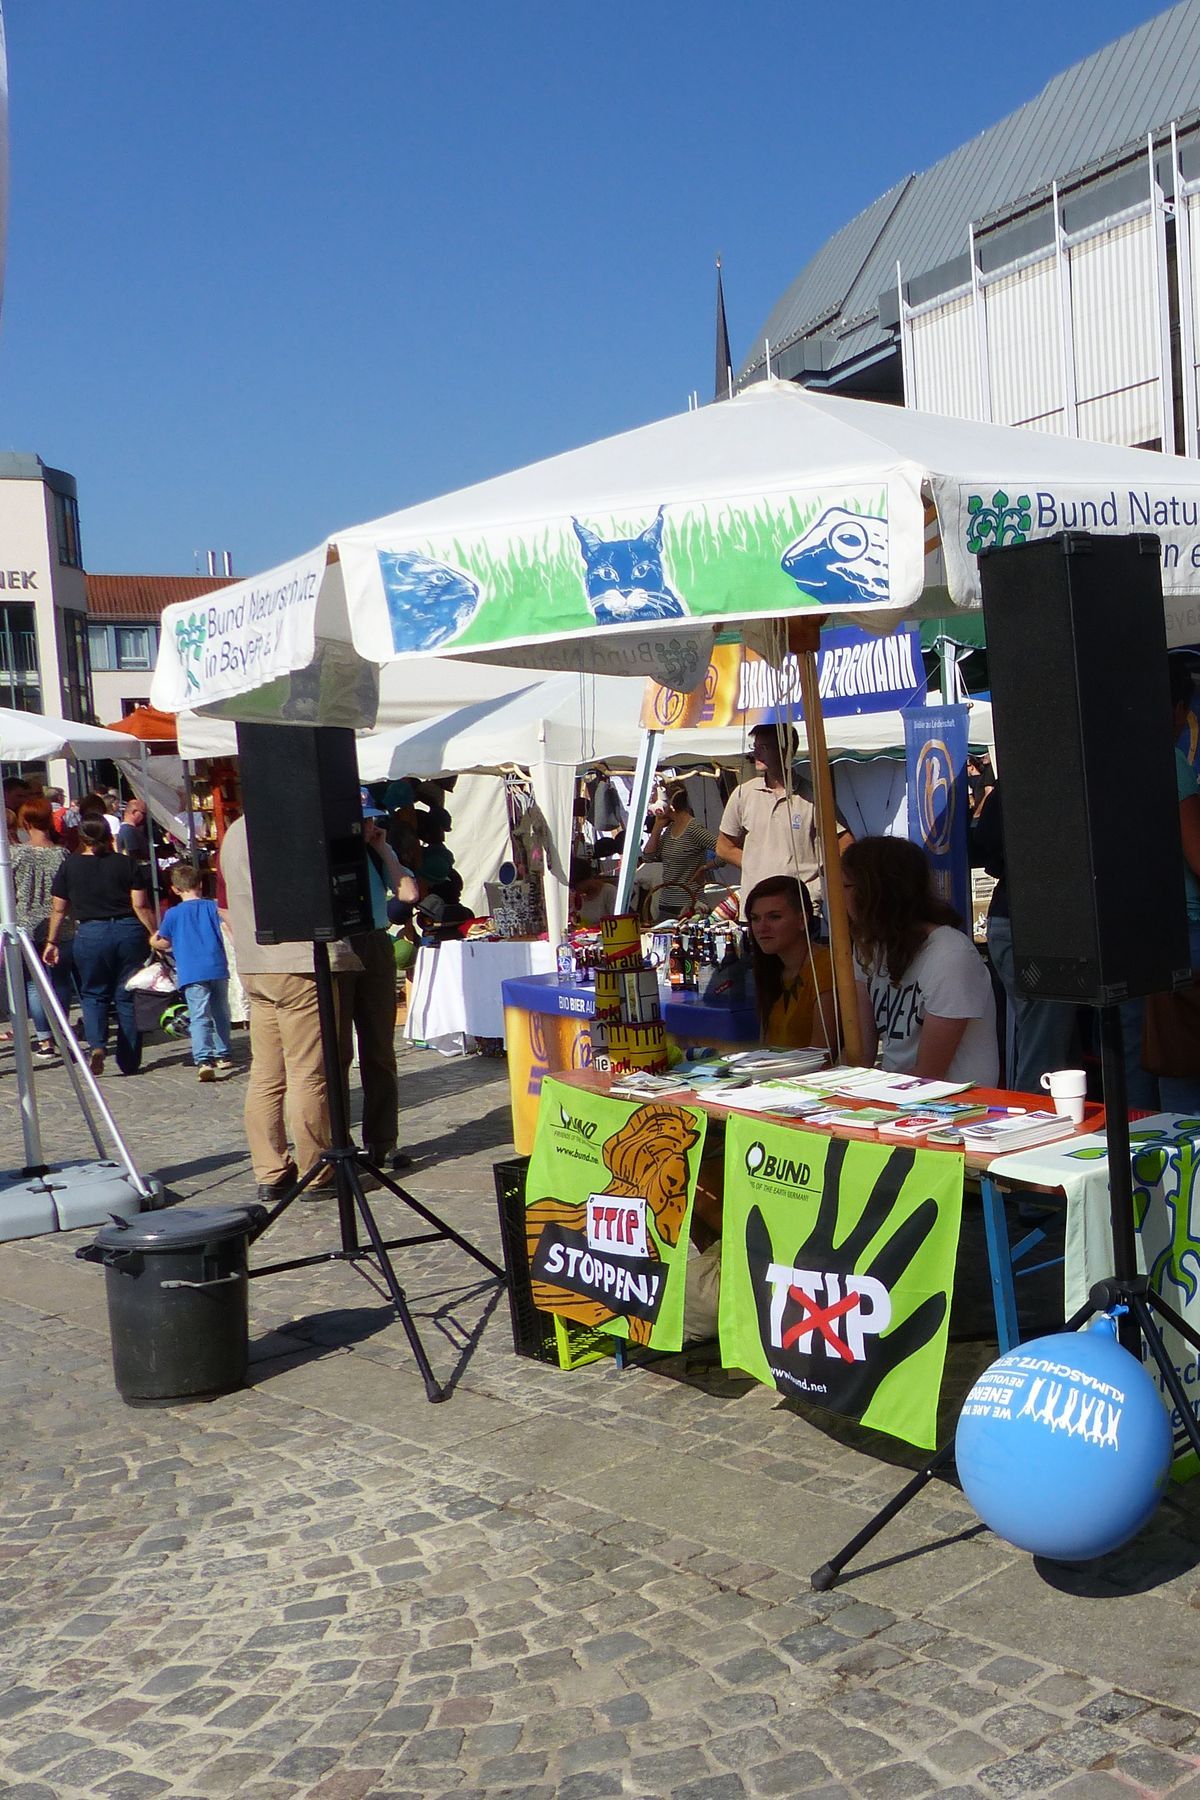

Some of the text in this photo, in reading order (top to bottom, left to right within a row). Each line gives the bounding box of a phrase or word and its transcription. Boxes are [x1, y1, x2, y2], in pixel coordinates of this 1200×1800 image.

[1037, 491, 1119, 528] Bund
[208, 572, 317, 639] Bund Naturschutz
[205, 648, 218, 679] in
[819, 633, 918, 700] BERGMANN
[558, 995, 570, 1010] BIO
[569, 997, 586, 1013] BIER
[763, 1155, 811, 1186] BUND
[592, 1206, 640, 1245] TTIP
[544, 1242, 661, 1308] STOPPEN!
[765, 1262, 893, 1362] TTIP
[1017, 1356, 1126, 1404] KLIMASCHUTZ
